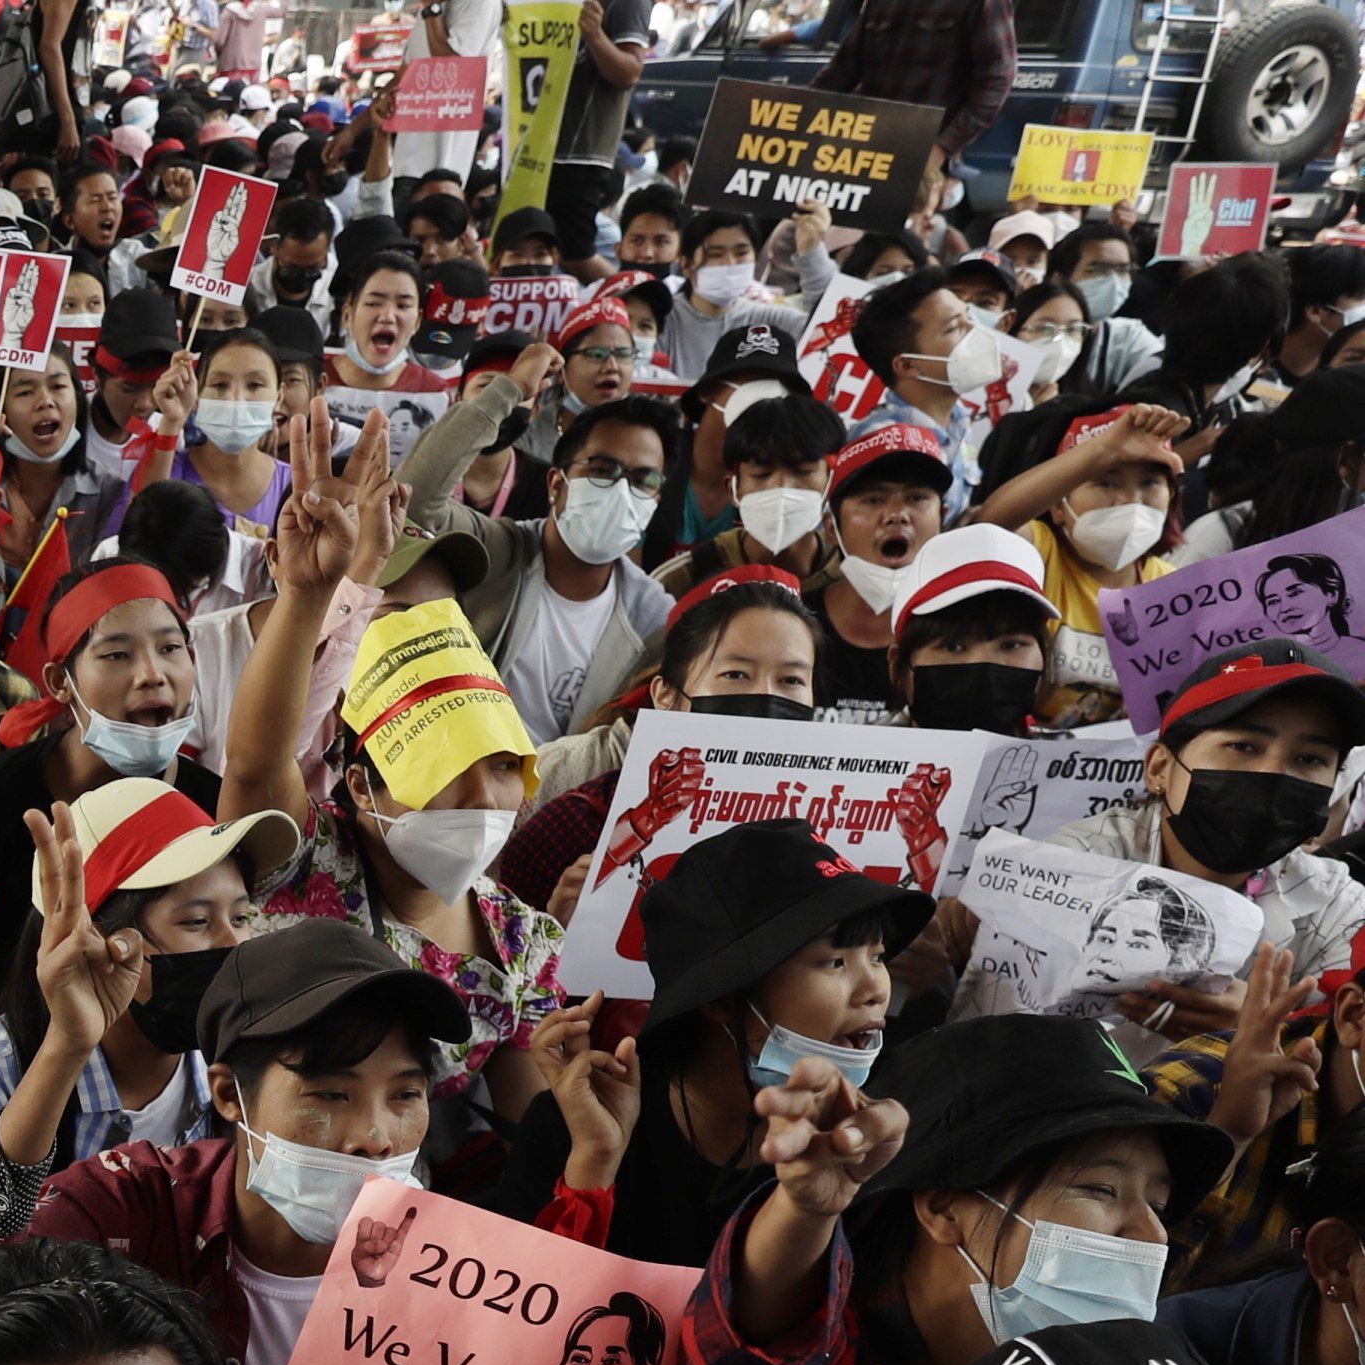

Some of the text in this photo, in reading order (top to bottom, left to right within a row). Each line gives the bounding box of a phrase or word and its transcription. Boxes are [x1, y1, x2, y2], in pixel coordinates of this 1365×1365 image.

[749, 98, 877, 143] WE ARE
[1027, 132, 1080, 151] LOVE
[735, 132, 895, 181] NOT SAFE
[723, 167, 871, 213] AT NIGHT
[1012, 182, 1137, 198] PLEASE JOIN CDM
[1218, 197, 1257, 222] Civil
[184, 272, 232, 298] #CDM
[489, 278, 578, 302] SUPPORT
[1144, 578, 1243, 628] 2020
[350, 631, 464, 706] Release Immediately
[1127, 625, 1267, 677] We Vote
[384, 671, 422, 712] Leader
[385, 740, 405, 764] AND
[404, 695, 467, 745] ARRESTED
[703, 748, 911, 776] CIVIL DISOBEDIENCE MOVEMENT
[984, 854, 1073, 889] WE WANT
[978, 873, 1094, 915] OUR LEADER
[410, 1242, 560, 1327] 2020
